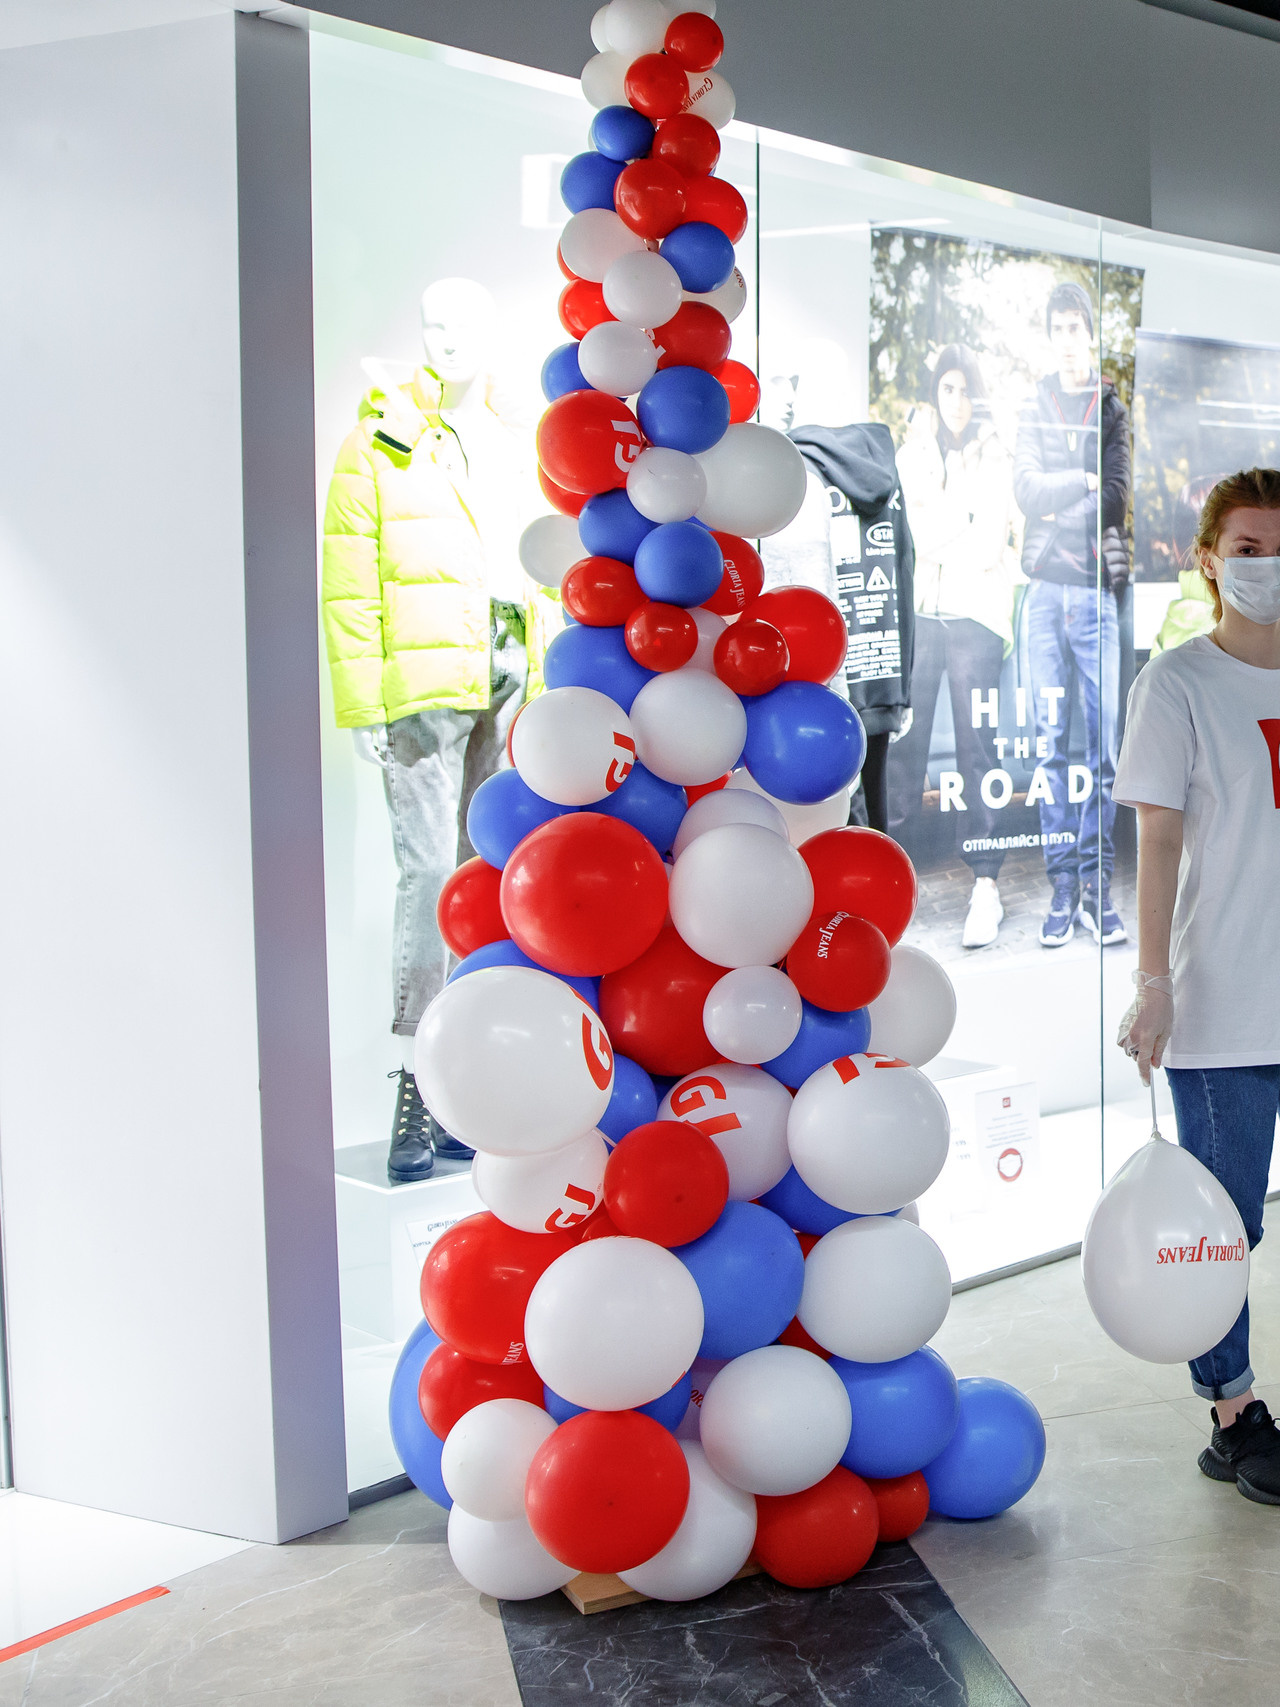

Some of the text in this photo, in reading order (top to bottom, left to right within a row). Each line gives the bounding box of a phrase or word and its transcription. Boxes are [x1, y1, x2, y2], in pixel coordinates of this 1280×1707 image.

[970, 686, 1065, 729] HIT
[992, 735, 1049, 760] THE
[939, 764, 1094, 813] ROAD
[962, 834, 1040, 853] ОТПРАВЛЯЙСЯ
[1049, 831, 1077, 845] ПУТЬ
[818, 927, 834, 959] JEANS
[544, 1183, 596, 1233] GJ
[1156, 1236, 1244, 1264] GLORIA JEANS
